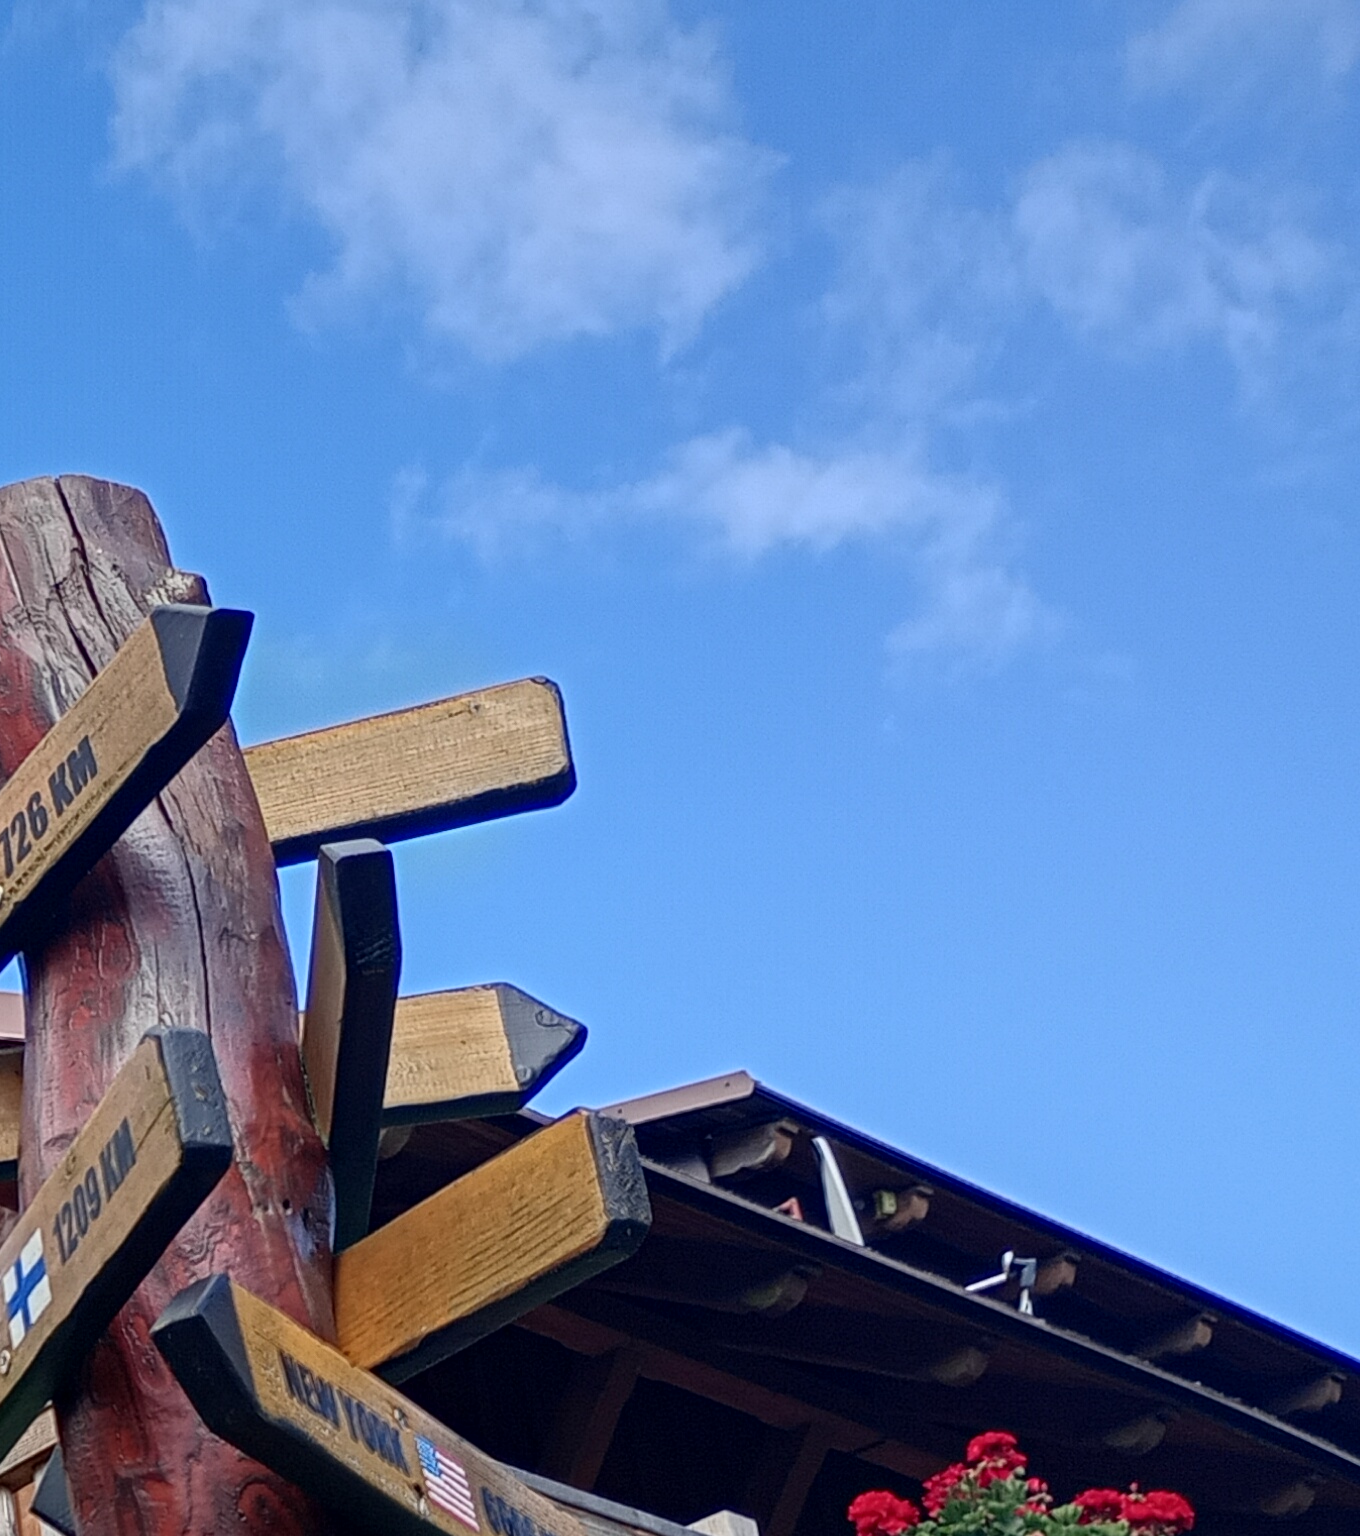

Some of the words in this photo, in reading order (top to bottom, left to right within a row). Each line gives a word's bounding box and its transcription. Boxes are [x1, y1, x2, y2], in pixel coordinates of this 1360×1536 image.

[48, 735, 99, 816] KM
[52, 1166, 101, 1266] 1209
[99, 1116, 137, 1197] KM
[281, 1350, 340, 1430] NEW
[336, 1388, 410, 1478] YORK
